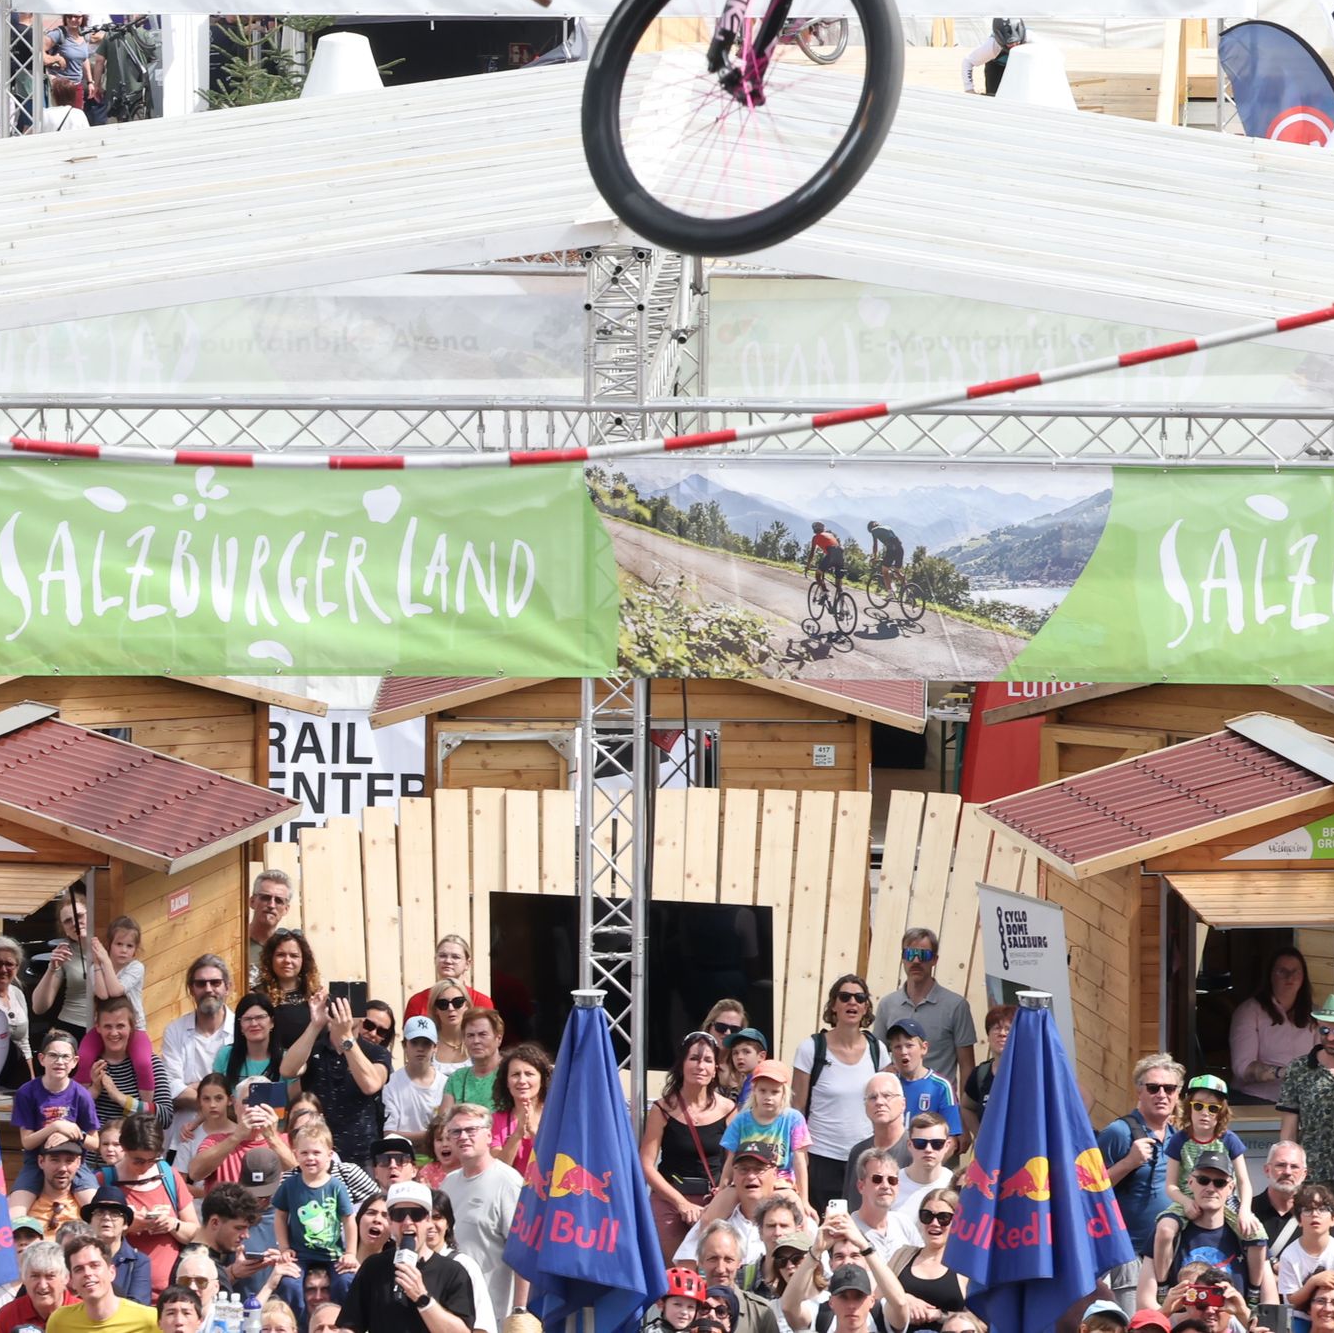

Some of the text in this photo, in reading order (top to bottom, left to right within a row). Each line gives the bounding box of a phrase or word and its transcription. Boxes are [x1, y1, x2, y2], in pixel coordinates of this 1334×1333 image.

[394, 328, 478, 353] Arena
[395, 517, 536, 626] LAND
[269, 721, 373, 765] RAIL
[269, 772, 426, 816] ENTER
[1004, 910, 1027, 923] CYCLO
[1007, 924, 1028, 936] DOME
[1008, 936, 1048, 949] SALZBURG
[551, 1212, 620, 1254] Bull
[993, 1211, 1040, 1251] Red
